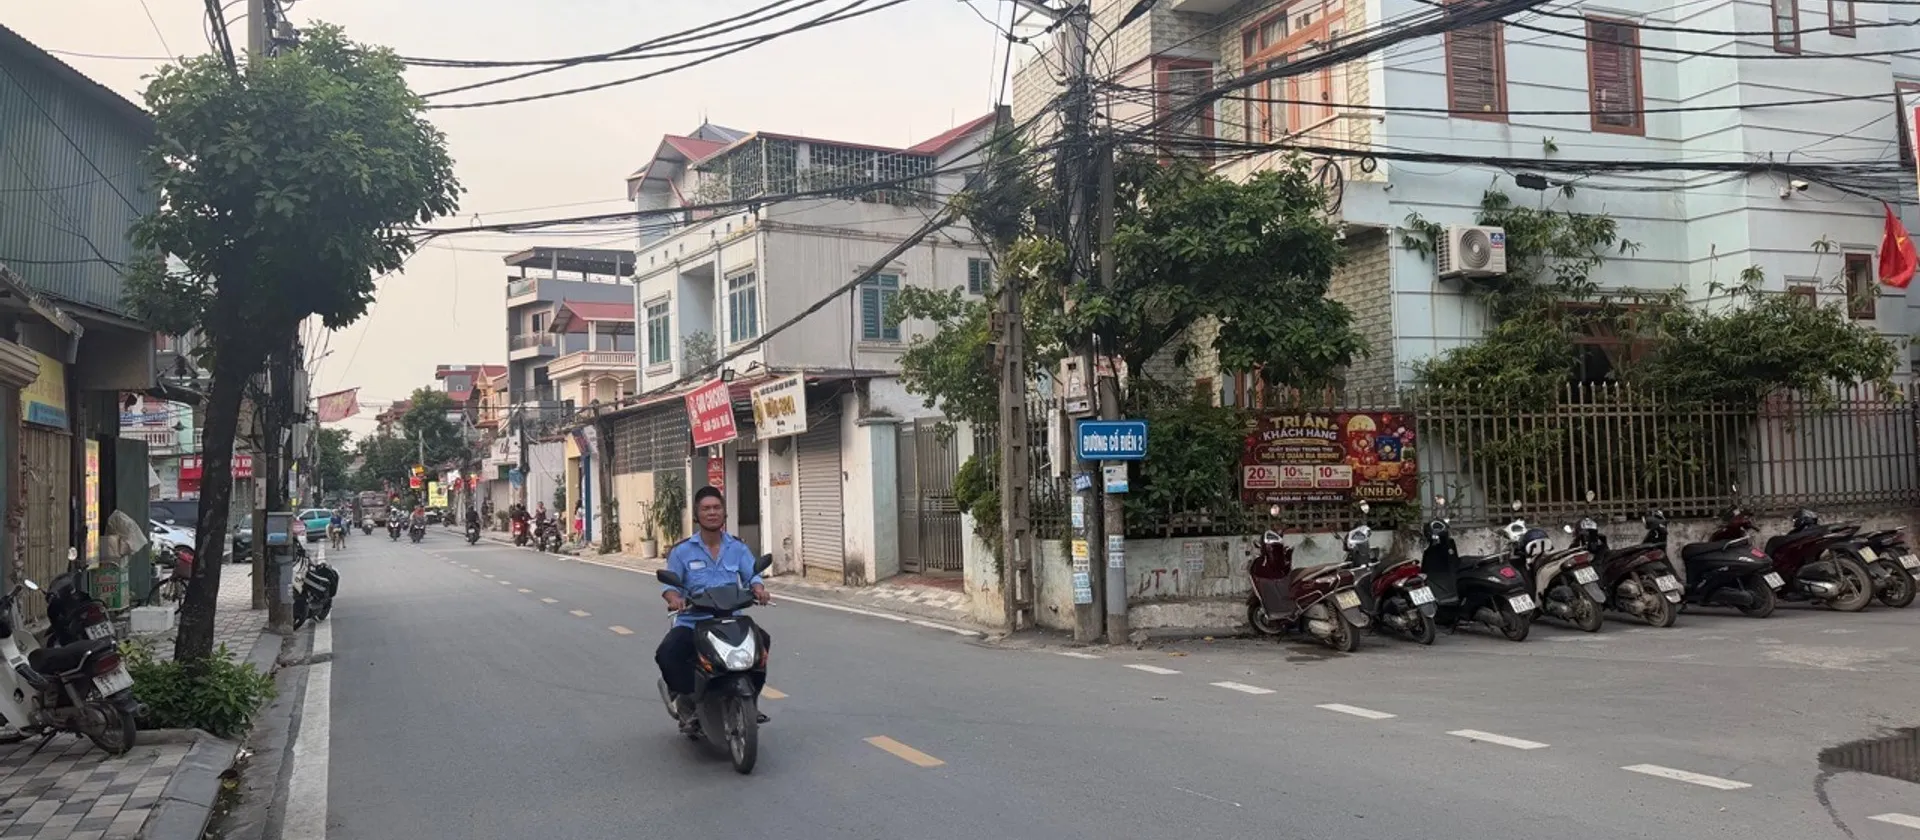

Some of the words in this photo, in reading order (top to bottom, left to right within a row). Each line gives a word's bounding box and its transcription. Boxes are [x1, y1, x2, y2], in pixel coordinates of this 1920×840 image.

[1270, 415, 1300, 429] TRI
[1302, 412, 1329, 429] ÂN
[1083, 430, 1108, 451] ĐƯỜNG
[1138, 434, 1143, 451] 2
[1263, 427, 1304, 441] KHÁCH
[1306, 427, 1337, 441] HÀNG
[1355, 486, 1384, 497] KINH
